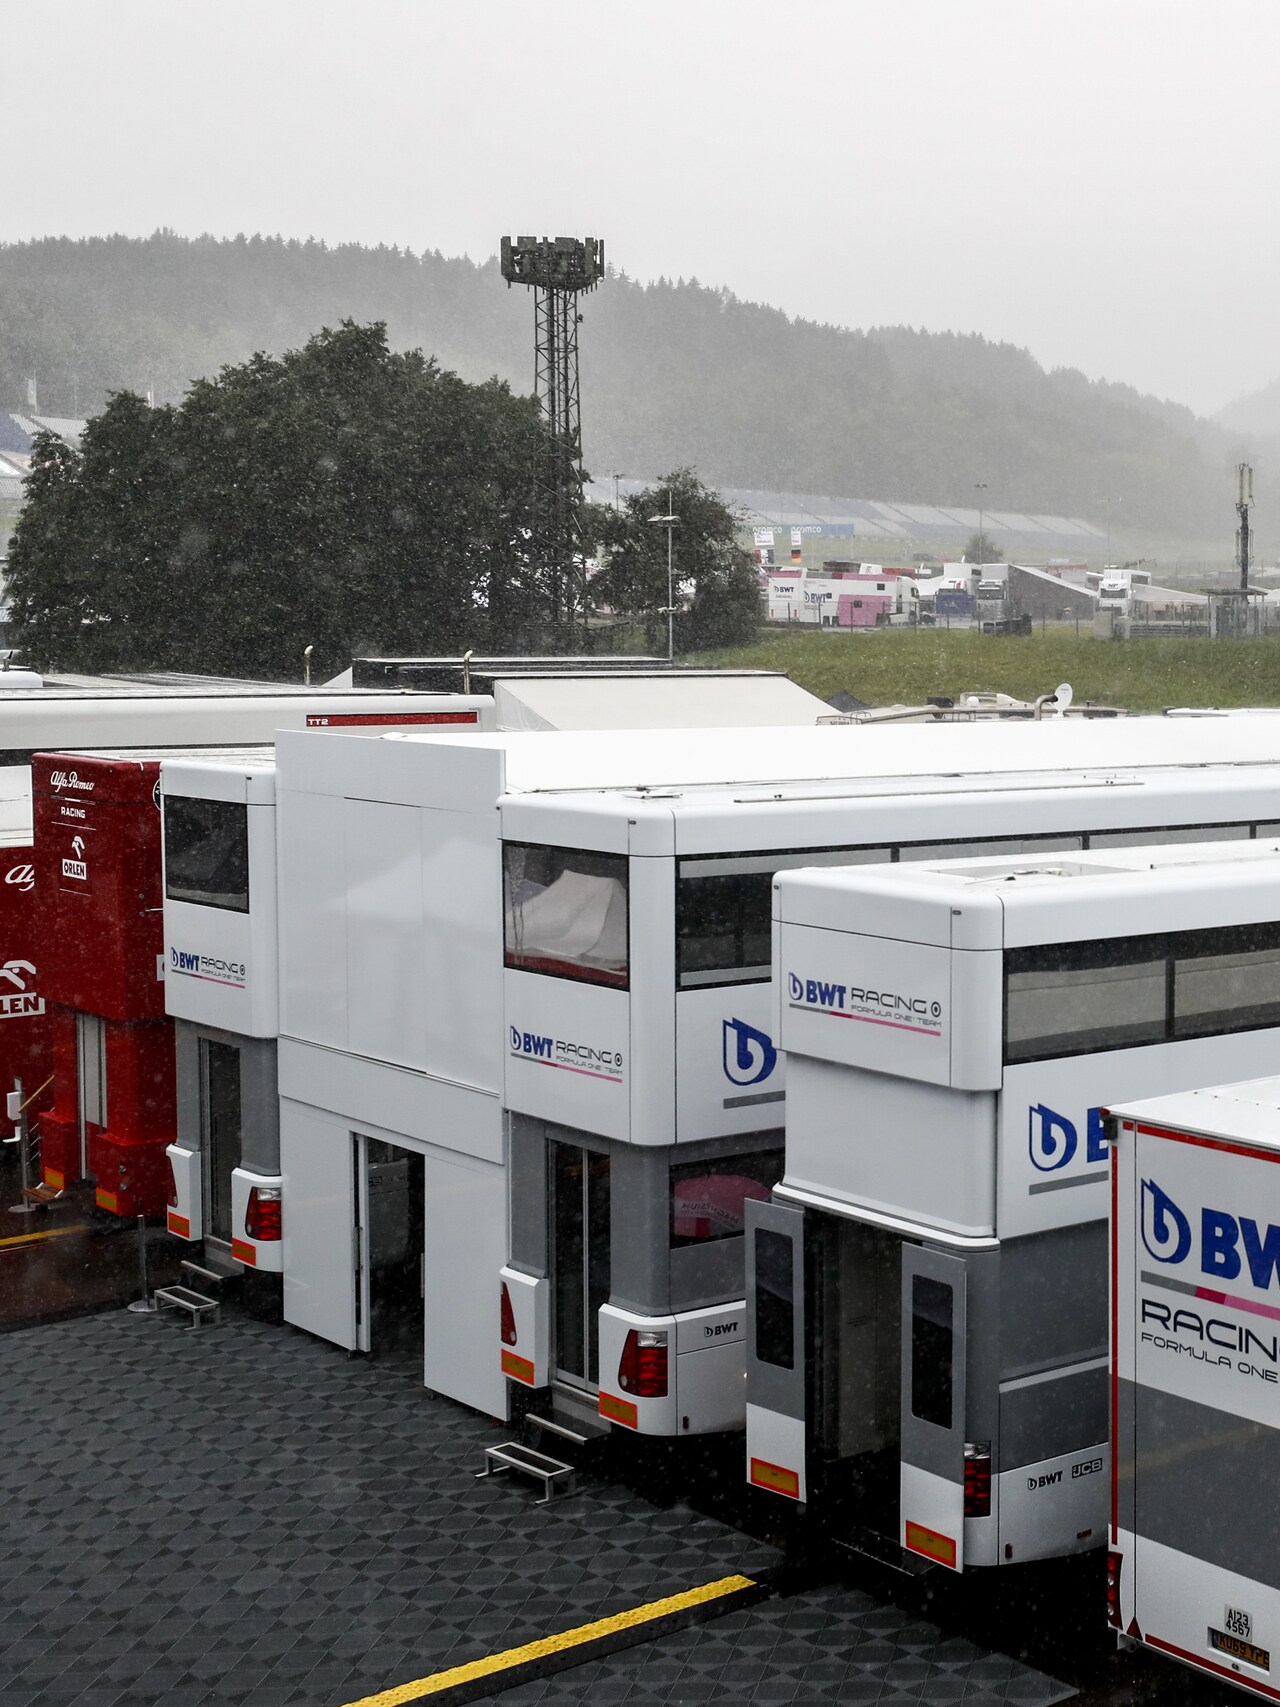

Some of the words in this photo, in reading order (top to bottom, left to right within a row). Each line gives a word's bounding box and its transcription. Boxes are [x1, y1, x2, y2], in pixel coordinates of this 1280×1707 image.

[61, 806, 86, 819] RACING
[64, 861, 85, 877] ORLEN
[180, 952, 199, 971] BWT
[201, 956, 238, 973] RACING
[805, 980, 846, 1008] BWT
[851, 987, 927, 1014] RACING
[851, 1004, 892, 1019] FORMULA
[918, 1018, 942, 1028] TEAM
[523, 1033, 553, 1059] BWT
[556, 1040, 612, 1064] RACING
[715, 1322, 738, 1335] BWT
[1142, 1332, 1232, 1369] FORMULA
[1038, 1471, 1063, 1488] BWT
[1073, 1461, 1102, 1477] JCB
[1228, 1608, 1249, 1627] A123
[1226, 1620, 1250, 1638] 4567
